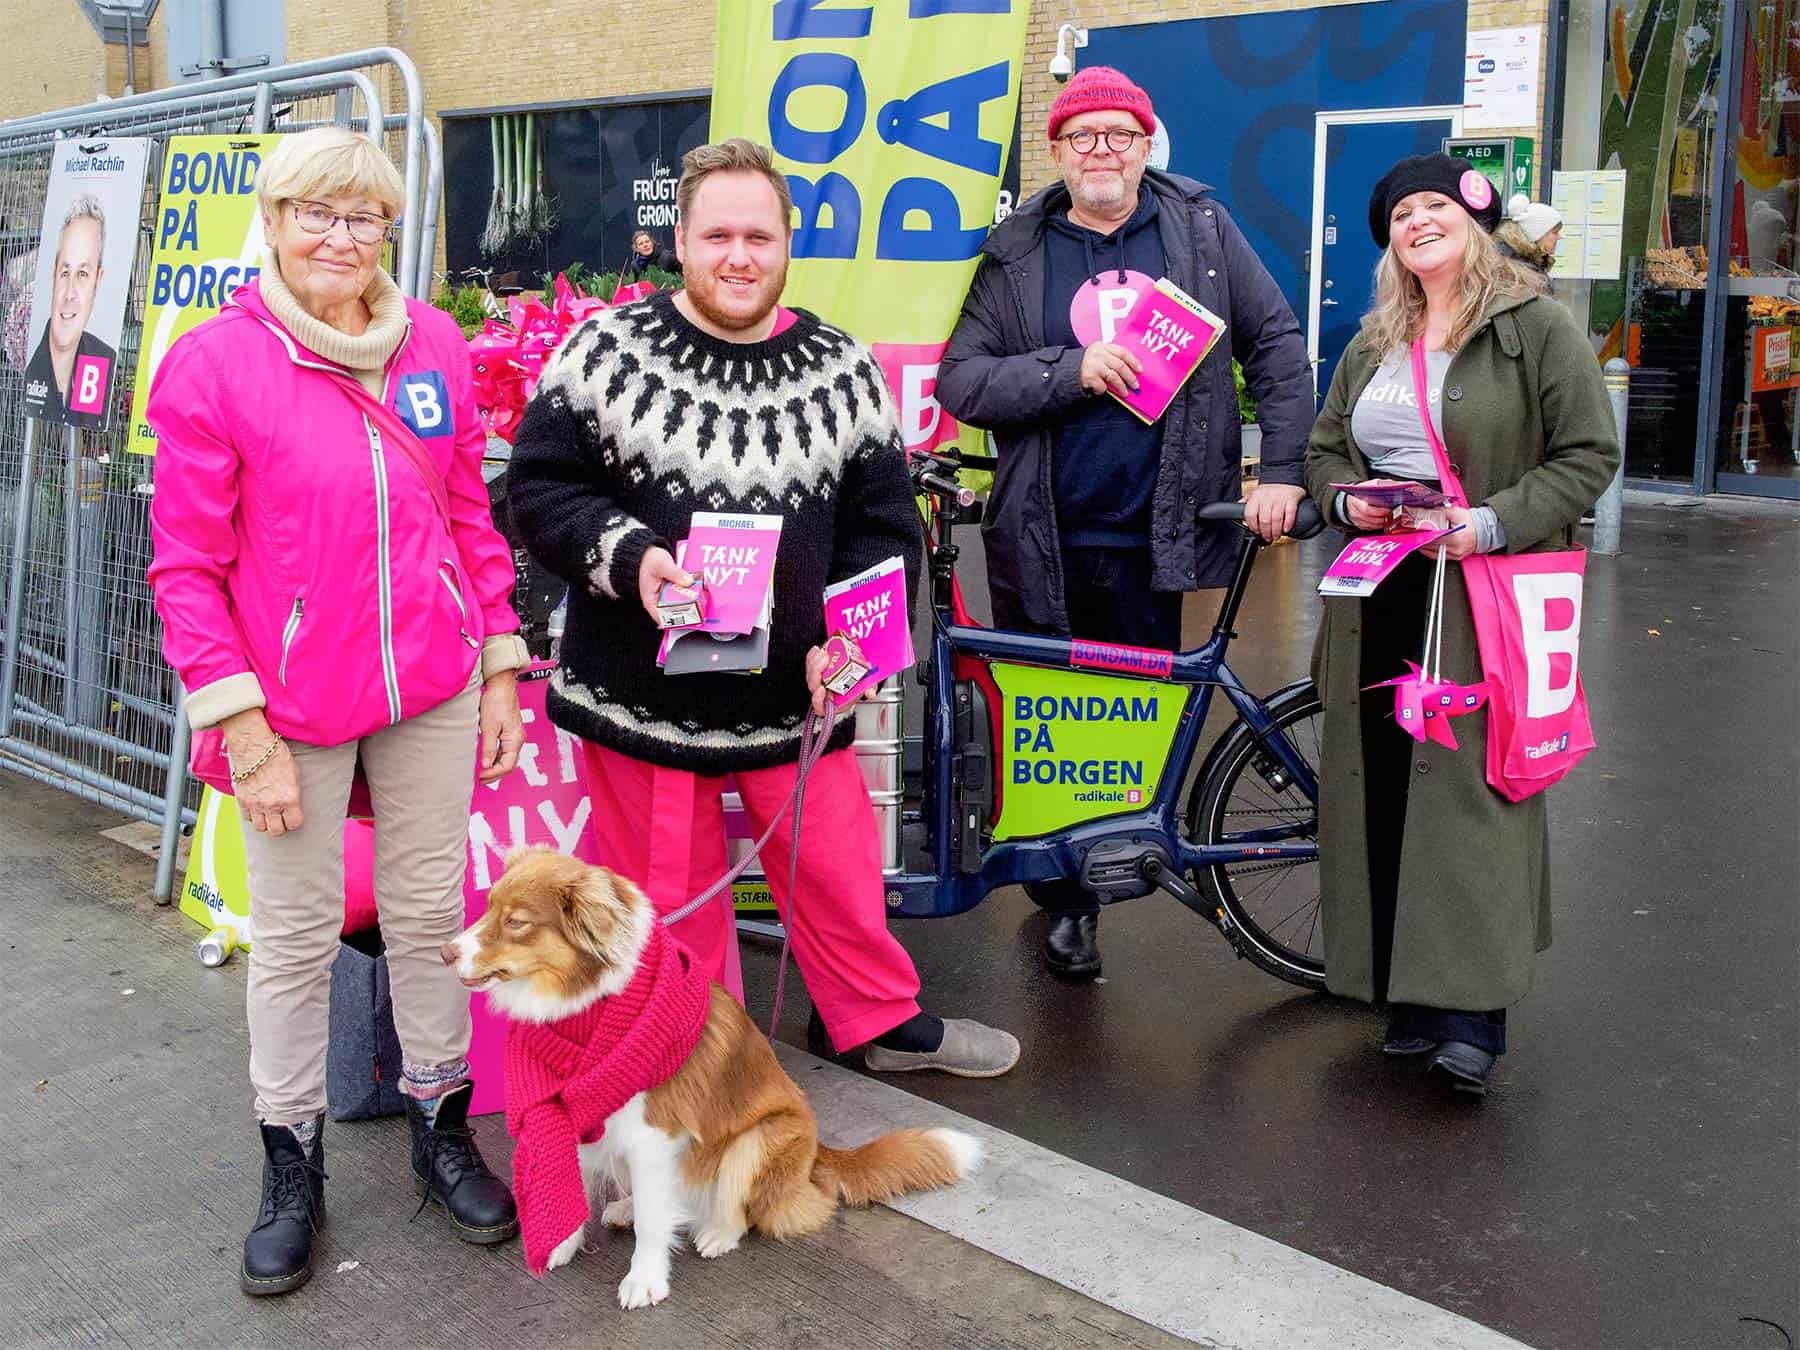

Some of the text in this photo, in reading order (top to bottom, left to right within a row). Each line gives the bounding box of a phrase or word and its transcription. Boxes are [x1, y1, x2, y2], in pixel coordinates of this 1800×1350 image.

[65, 156, 124, 172] Michael Rachlin
[875, 59, 1010, 262] PÅ
[1466, 147, 1492, 157] AED
[168, 152, 261, 195] BOND
[633, 178, 678, 200] FRUGT
[160, 199, 198, 250] PÅ
[1149, 309, 1195, 349] TÆNK
[1140, 329, 1179, 361] NYT
[79, 364, 99, 404] B
[406, 383, 443, 429] B
[719, 519, 755, 528] MICHAEL
[700, 544, 760, 565] TÆNK
[703, 566, 750, 587] NYT
[841, 590, 892, 626] TÆNK
[850, 610, 888, 639] NYT
[1074, 642, 1169, 672] BONDAM.DK
[1512, 572, 1583, 718] B
[1014, 695, 1158, 721] BONDAM
[1014, 723, 1054, 752] PÅ
[1012, 760, 1142, 785] BORGEN
[1074, 790, 1139, 802] radikale B
[188, 880, 224, 913] radikale
